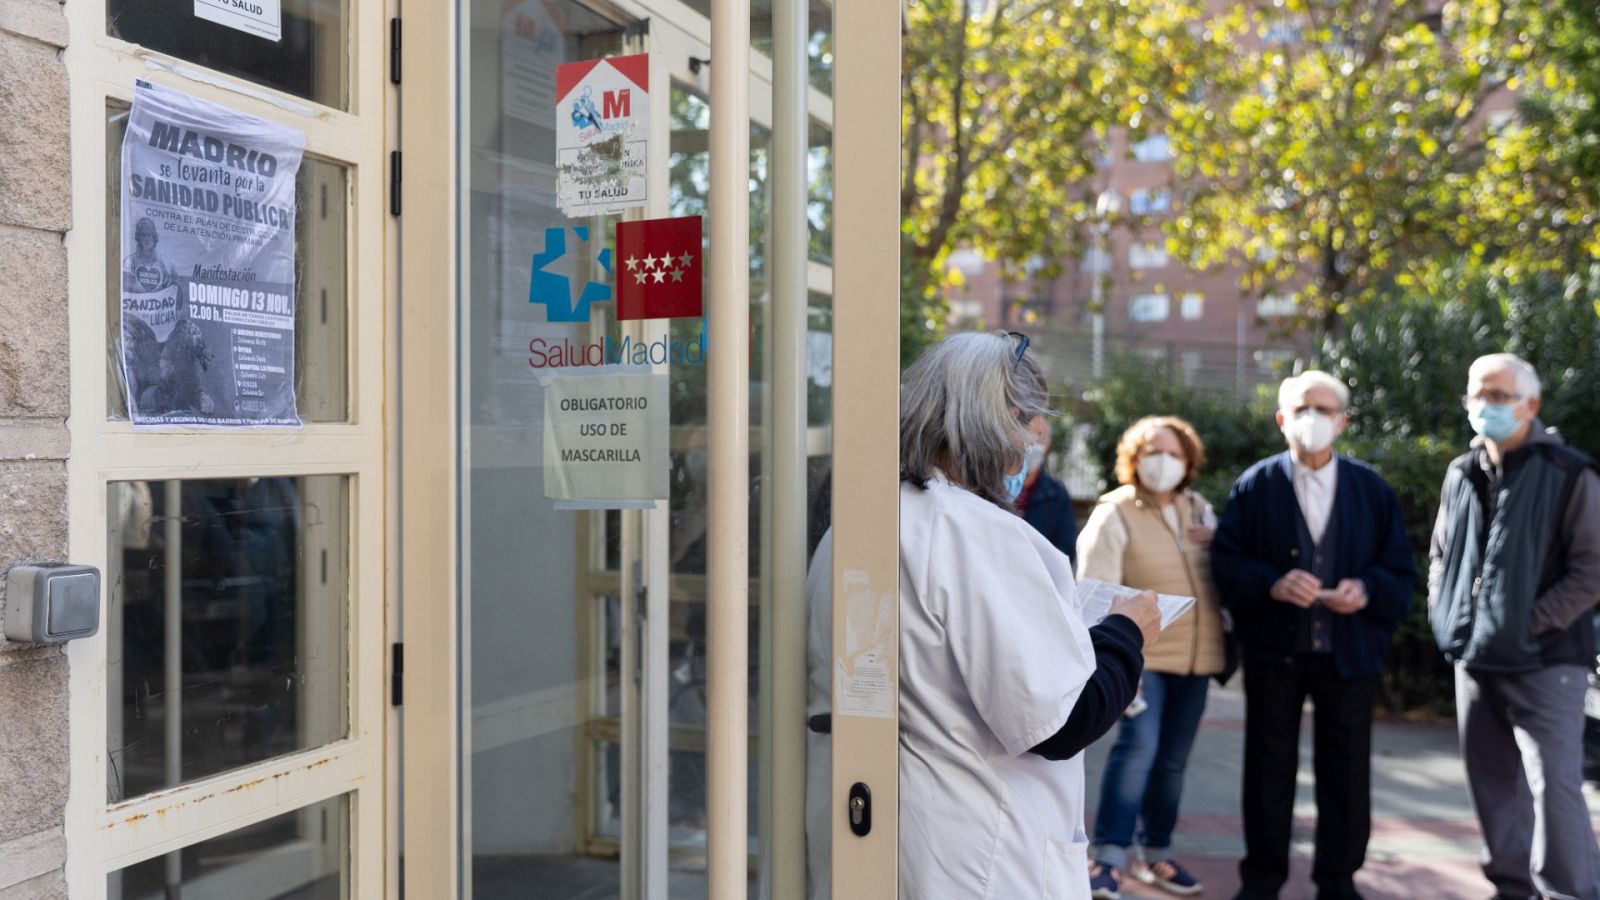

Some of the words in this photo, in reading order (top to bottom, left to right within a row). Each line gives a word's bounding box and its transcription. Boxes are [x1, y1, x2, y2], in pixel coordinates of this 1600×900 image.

[232, 0, 263, 15] SALUD
[149, 121, 278, 178] MADRID
[159, 163, 172, 177] se
[177, 157, 231, 186] levanta
[234, 177, 252, 194] por
[256, 180, 265, 192] la
[129, 173, 219, 212] SANIDAD
[223, 193, 289, 230] PÚBLICA
[578, 190, 592, 200] TU
[594, 188, 629, 199] SALUD
[145, 208, 181, 221] CONTRA
[184, 216, 194, 224] EL
[196, 218, 218, 229] PLAN
[219, 222, 231, 231] DE
[164, 222, 175, 231] DE
[190, 227, 232, 242] ATENCIÓN
[193, 264, 256, 282] Manifestación
[123, 297, 175, 311] SANIDAD
[189, 282, 249, 309] DOMINGO
[251, 291, 265, 311] 13
[266, 294, 291, 315] NOV.
[189, 304, 212, 320] 12.00
[214, 307, 222, 322] h.
[528, 333, 706, 369] SaludMadrid
[560, 396, 647, 412] OBLIGATORIO
[580, 424, 607, 437] USO
[610, 423, 628, 436] DE
[561, 449, 641, 462] MASCARILLA
